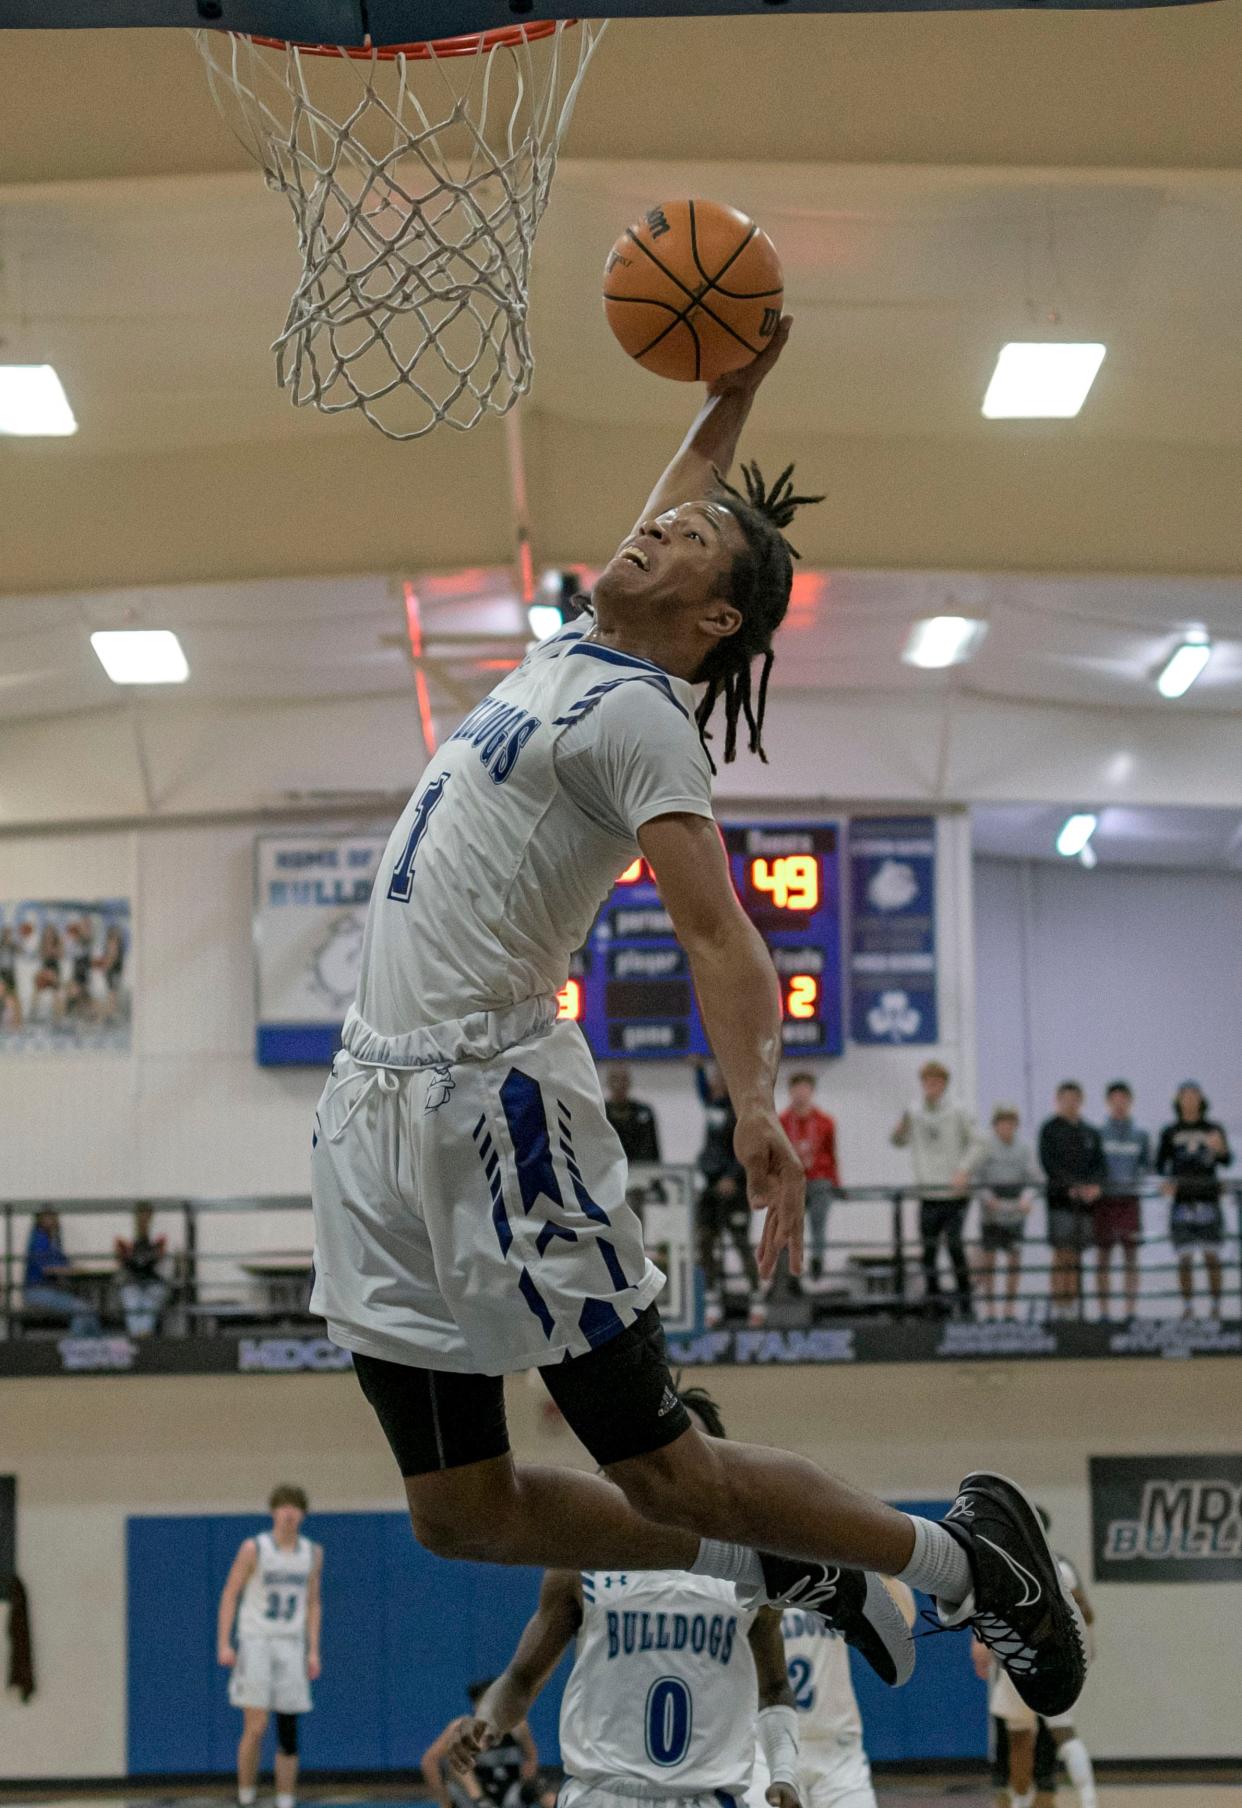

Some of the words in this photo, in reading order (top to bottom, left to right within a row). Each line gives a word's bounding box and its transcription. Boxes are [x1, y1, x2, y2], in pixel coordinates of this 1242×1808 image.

[387, 772, 451, 903] 1
[752, 854, 819, 911] 49
[787, 975, 818, 1019] 2
[607, 1610, 737, 1666] BULLDOGS
[644, 1675, 693, 1767] 0
